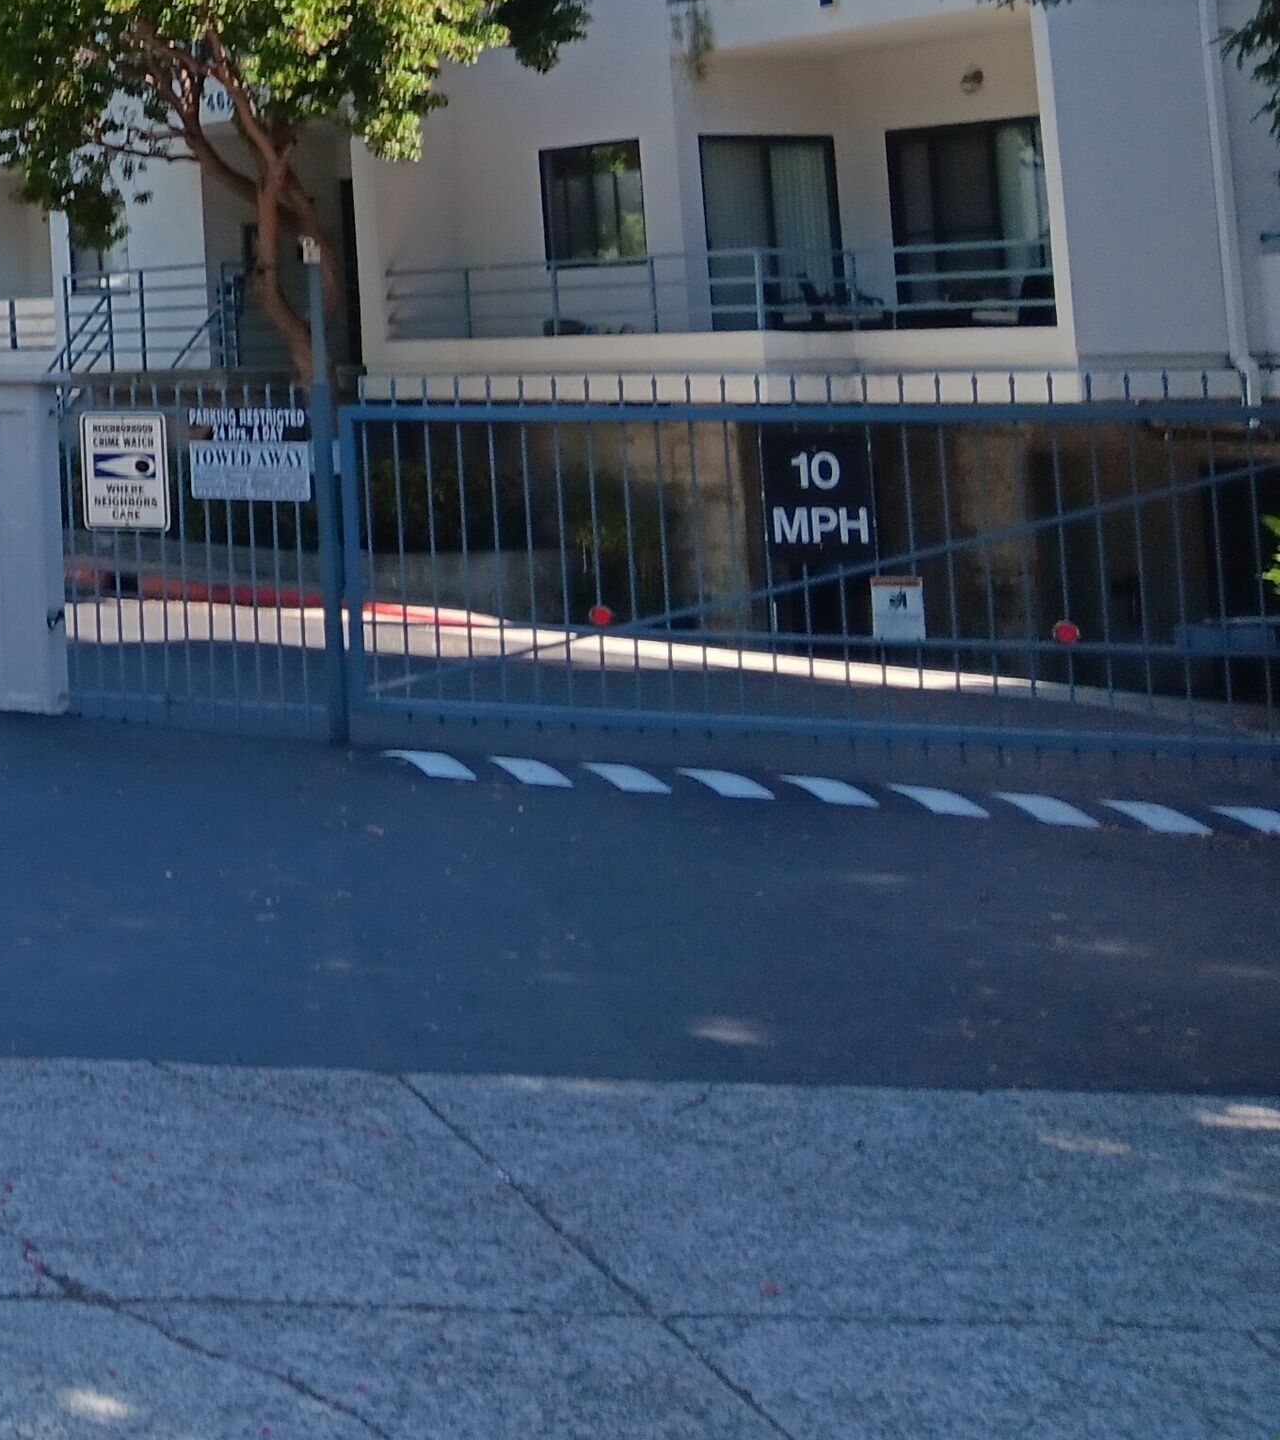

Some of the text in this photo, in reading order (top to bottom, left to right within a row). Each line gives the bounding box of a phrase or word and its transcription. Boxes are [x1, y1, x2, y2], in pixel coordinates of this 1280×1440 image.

[188, 408, 305, 427] PARKING RESTRICTED
[92, 424, 154, 434] NEIGHBORHOOD
[252, 424, 260, 441] A
[262, 424, 284, 442] DAY
[92, 438, 154, 449] CRIME WATCH
[193, 448, 303, 468] TOWED AWAY
[791, 450, 841, 490] 10
[106, 483, 144, 494] WHERE
[94, 496, 158, 508] NEIGHBORS
[112, 510, 141, 521] CARE
[772, 506, 869, 545] MPH
